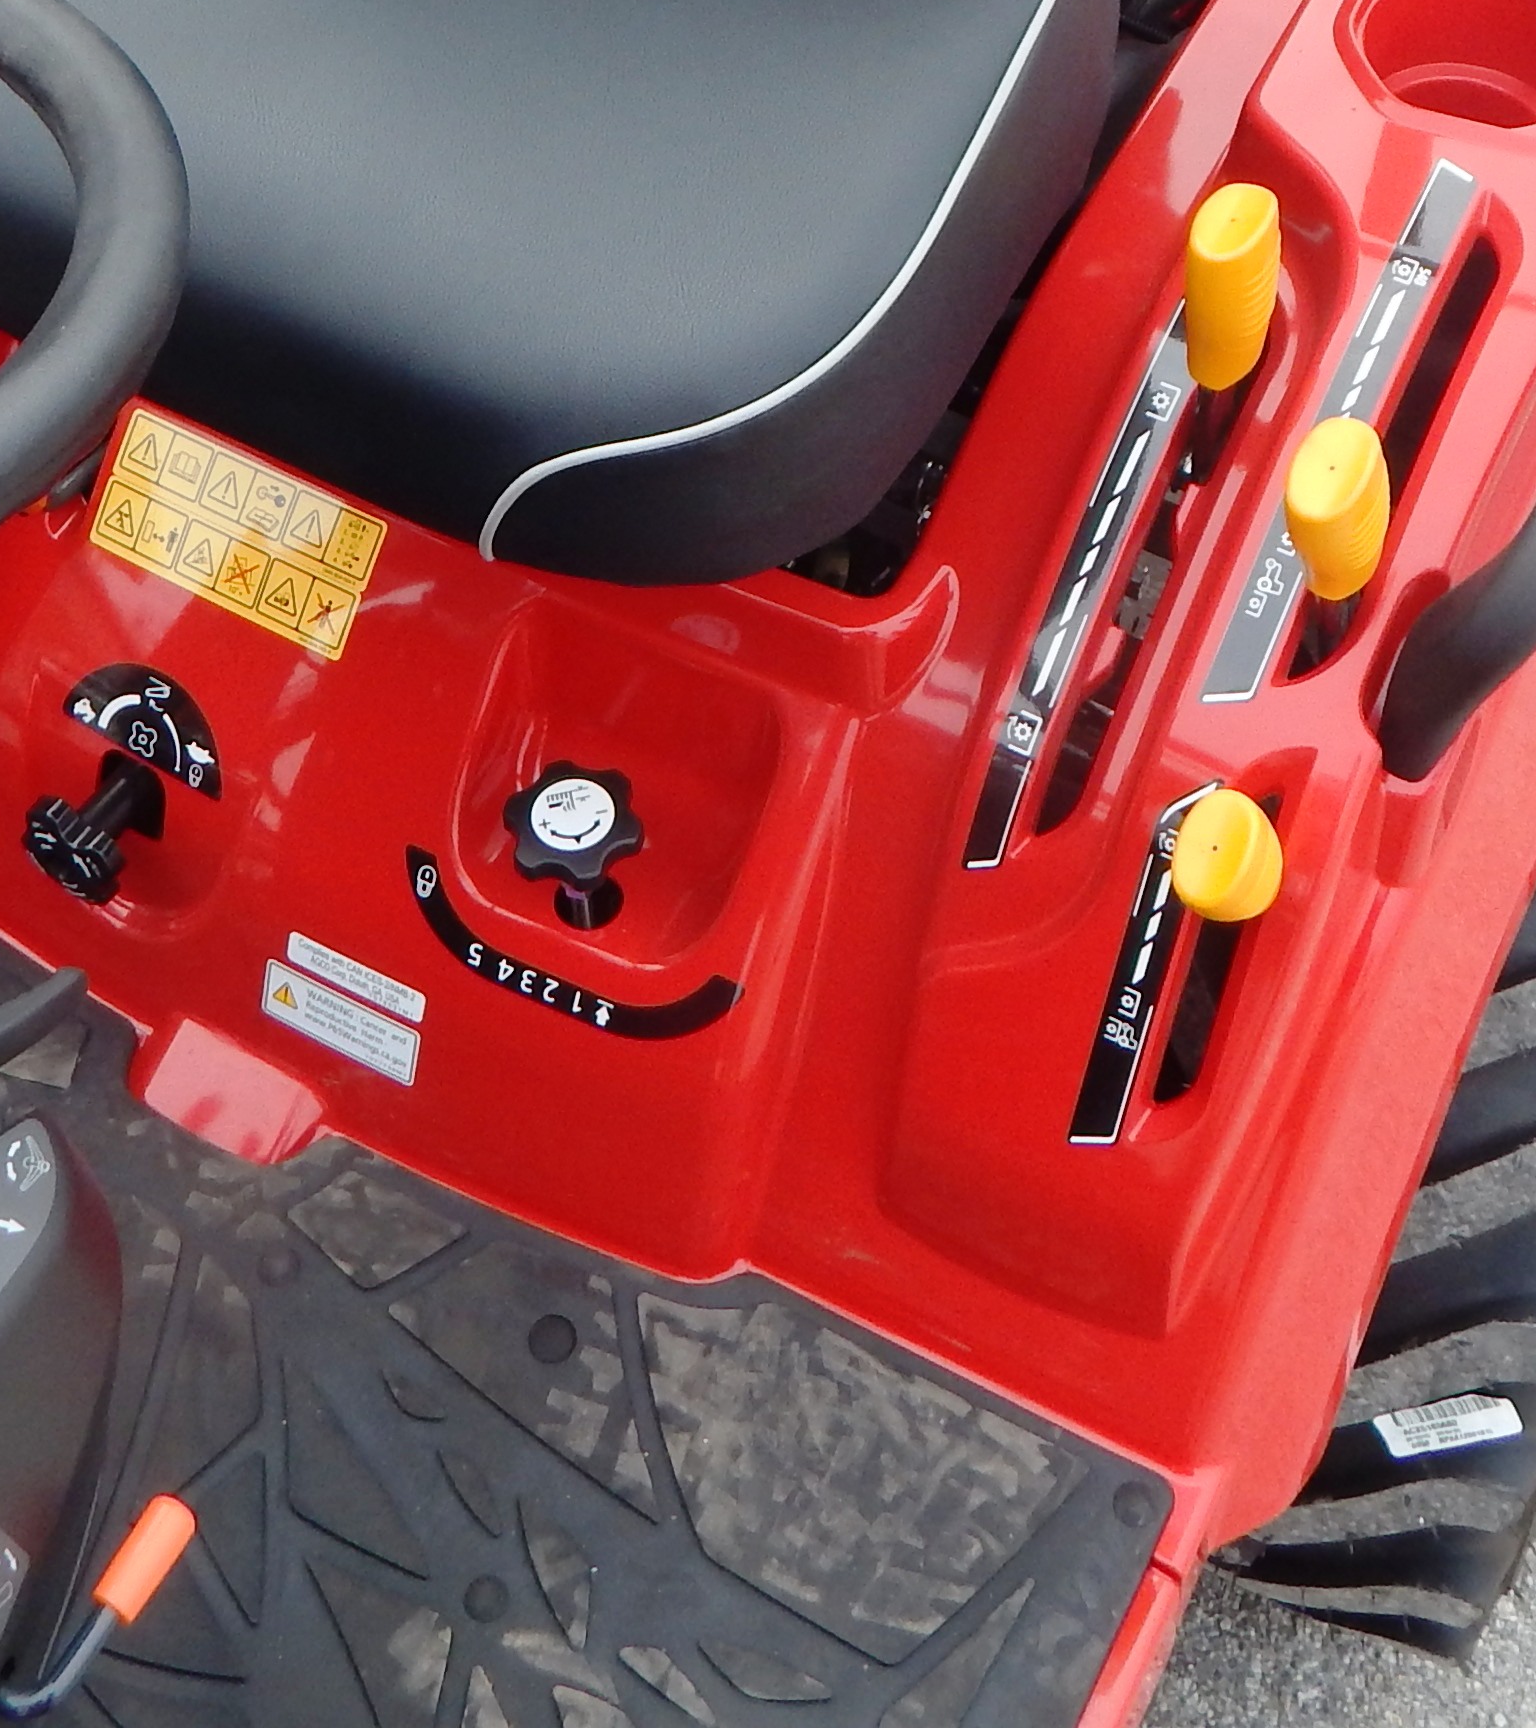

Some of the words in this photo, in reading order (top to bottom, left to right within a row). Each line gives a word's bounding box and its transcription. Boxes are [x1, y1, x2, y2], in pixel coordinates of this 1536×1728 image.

[467, 943, 484, 968] 5
[498, 958, 515, 983] 4
[520, 969, 538, 994] 3
[542, 978, 560, 1004] 2
[571, 990, 582, 1014] 1
